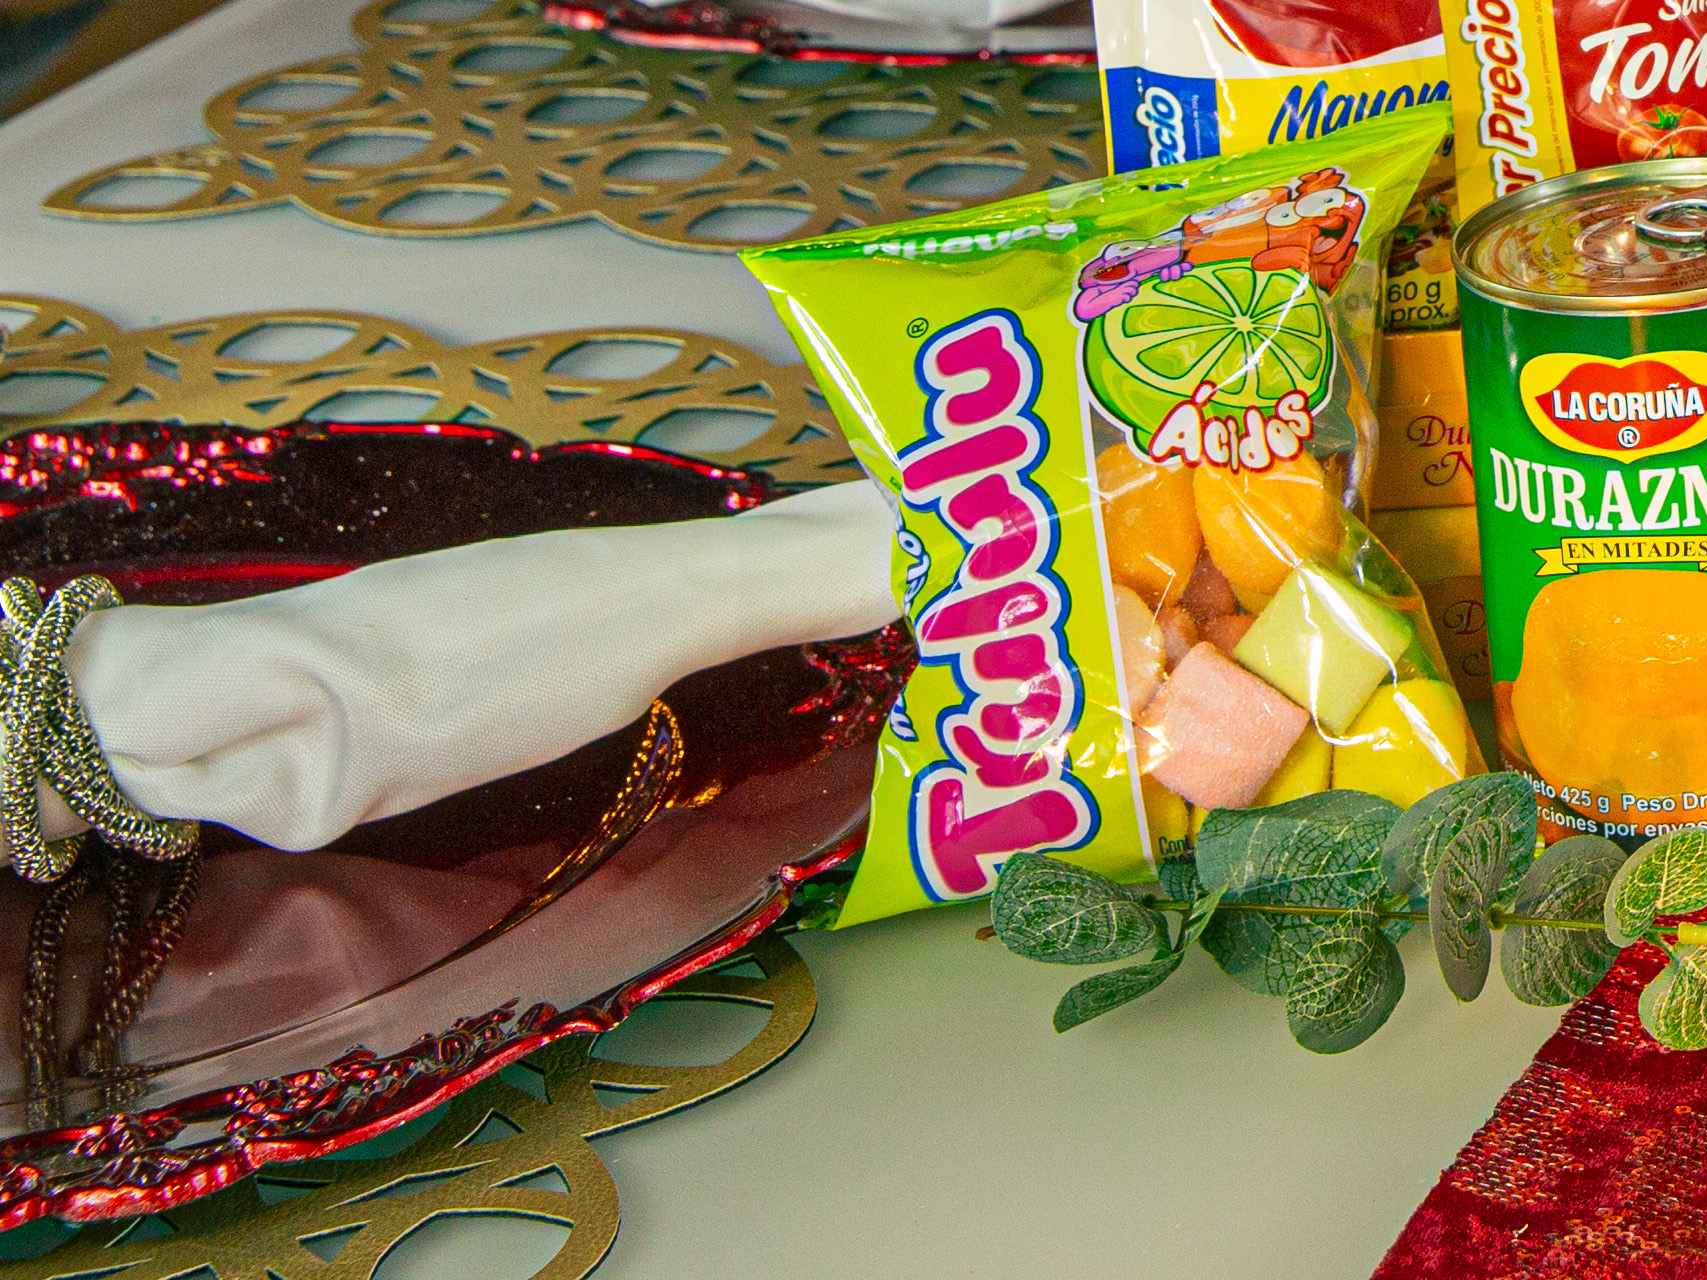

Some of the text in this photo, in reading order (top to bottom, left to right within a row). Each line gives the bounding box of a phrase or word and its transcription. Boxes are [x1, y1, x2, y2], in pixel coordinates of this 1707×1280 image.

[1426, 281, 1441, 304] g
[1147, 380, 1315, 473] Ácidos
[1566, 542, 1597, 561] EN
[902, 315, 1094, 899] Trululu
[1523, 770, 1555, 799] Neto
[1560, 786, 1591, 807] 425
[1597, 793, 1609, 813] g
[1622, 794, 1675, 812] Peso
[1604, 821, 1637, 838] por
